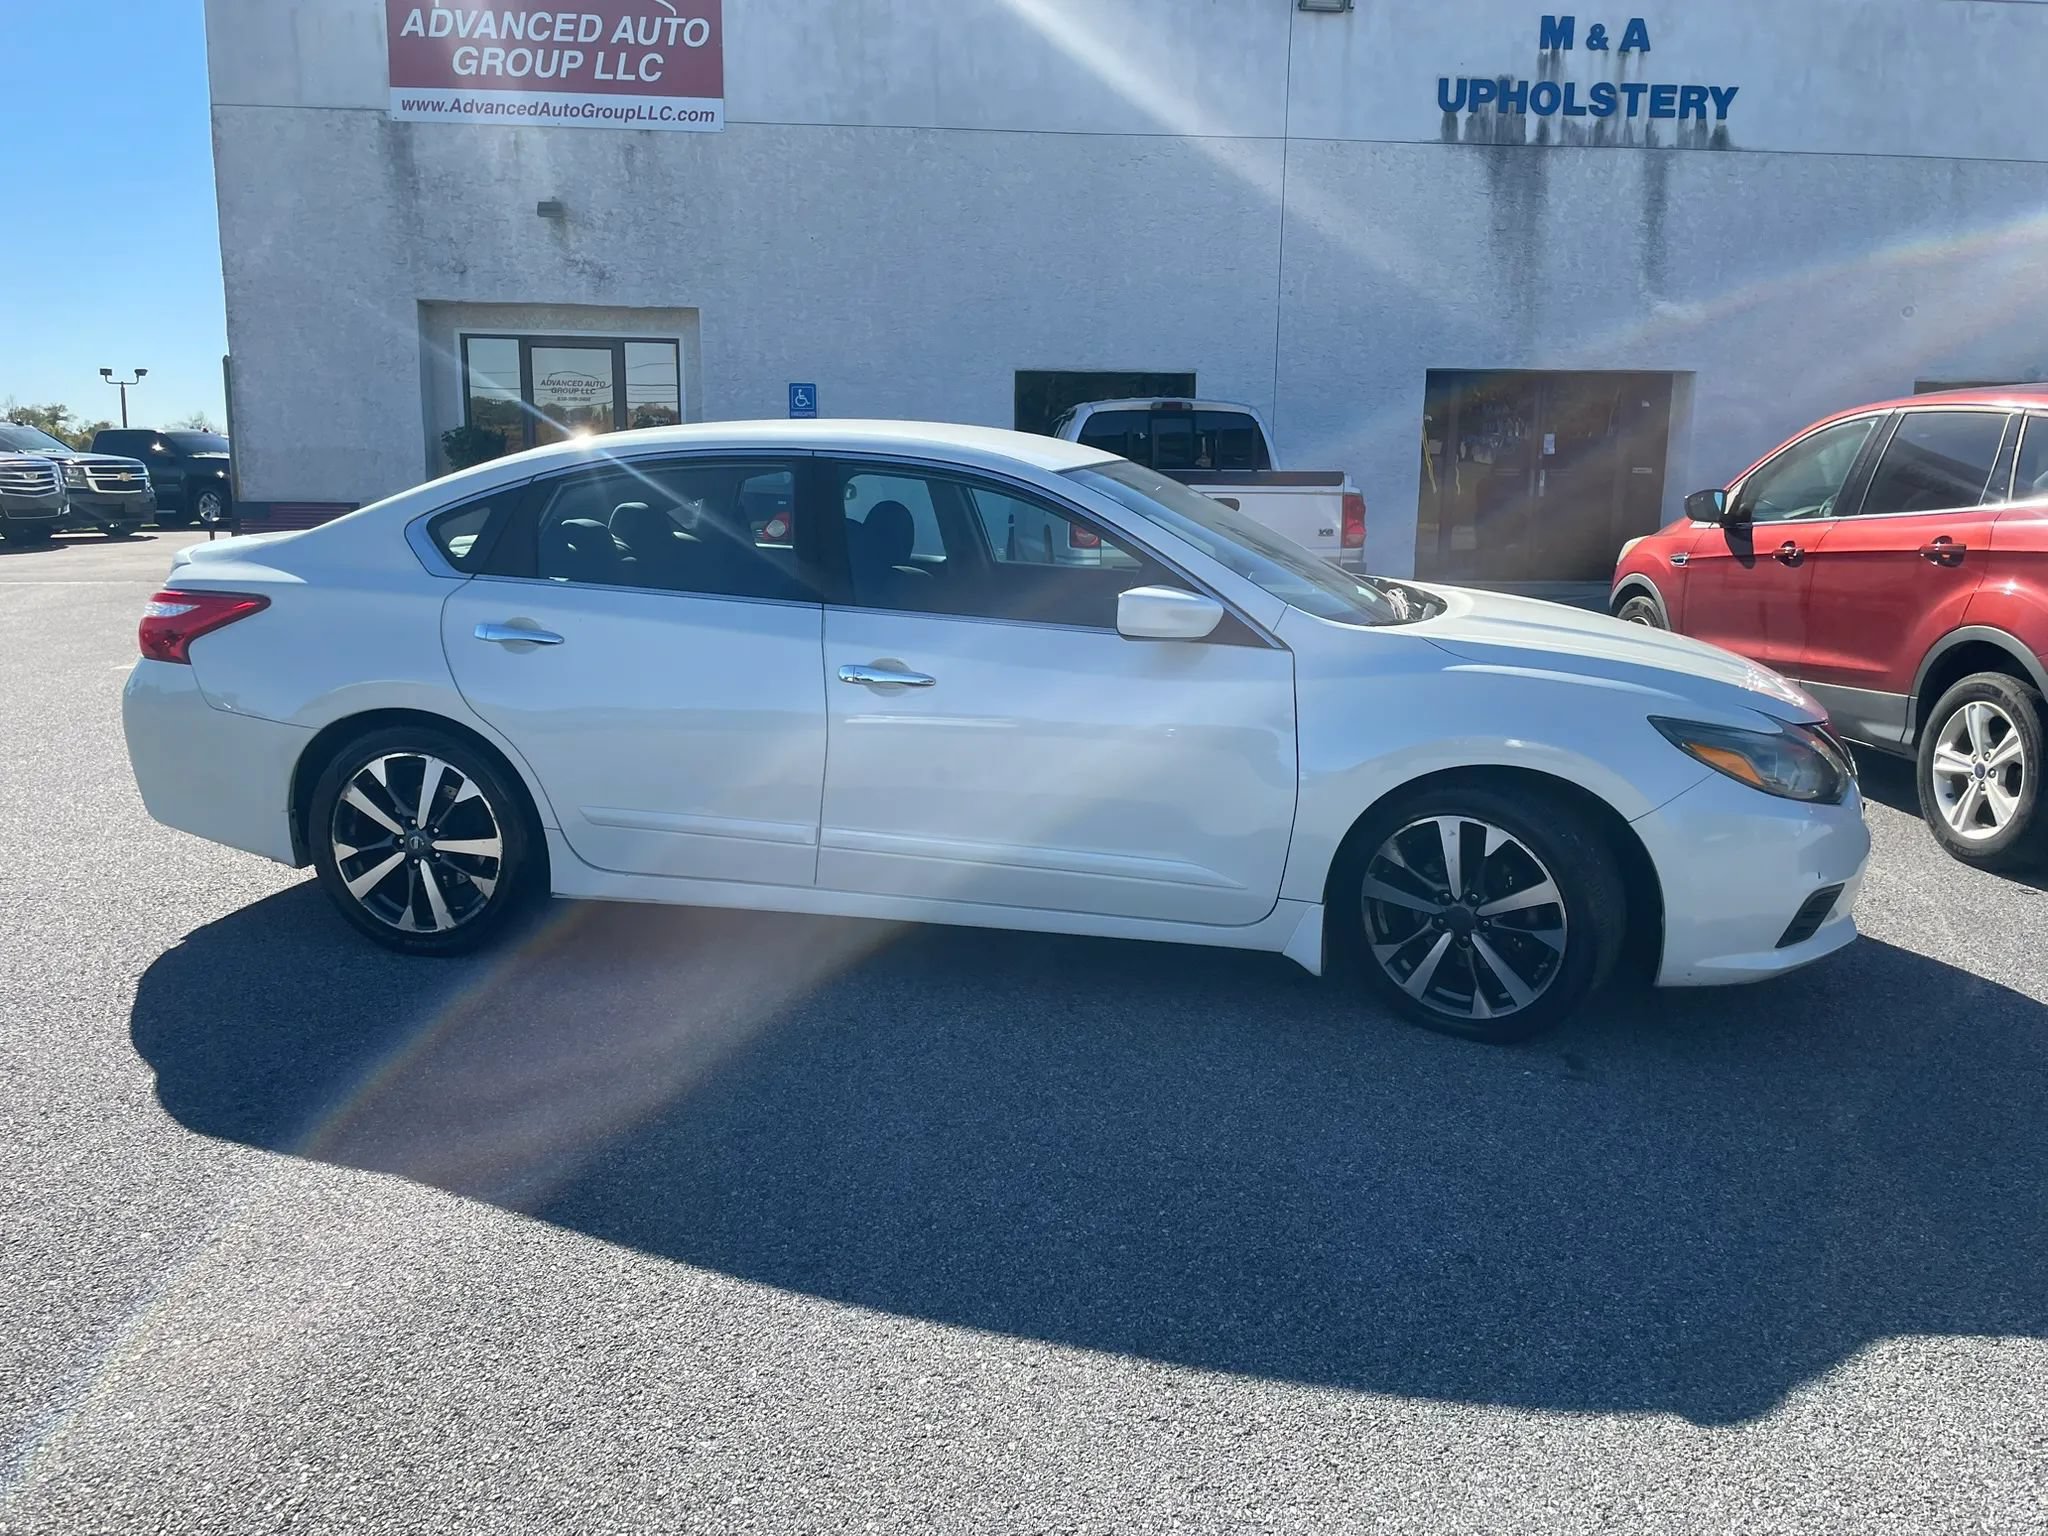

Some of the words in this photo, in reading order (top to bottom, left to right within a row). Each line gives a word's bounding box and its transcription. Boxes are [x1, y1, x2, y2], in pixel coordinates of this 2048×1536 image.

[400, 8, 602, 43] ADVANCED
[610, 16, 710, 48] AUTO
[1539, 15, 1576, 50] M
[1586, 23, 1609, 51] &
[1617, 18, 1651, 52] A
[452, 46, 584, 79] GROUP
[593, 52, 665, 82] LLC
[401, 98, 716, 123] www.AdvancedAutoGroupLLC.com
[1437, 77, 1740, 120] UPHOLSTERY
